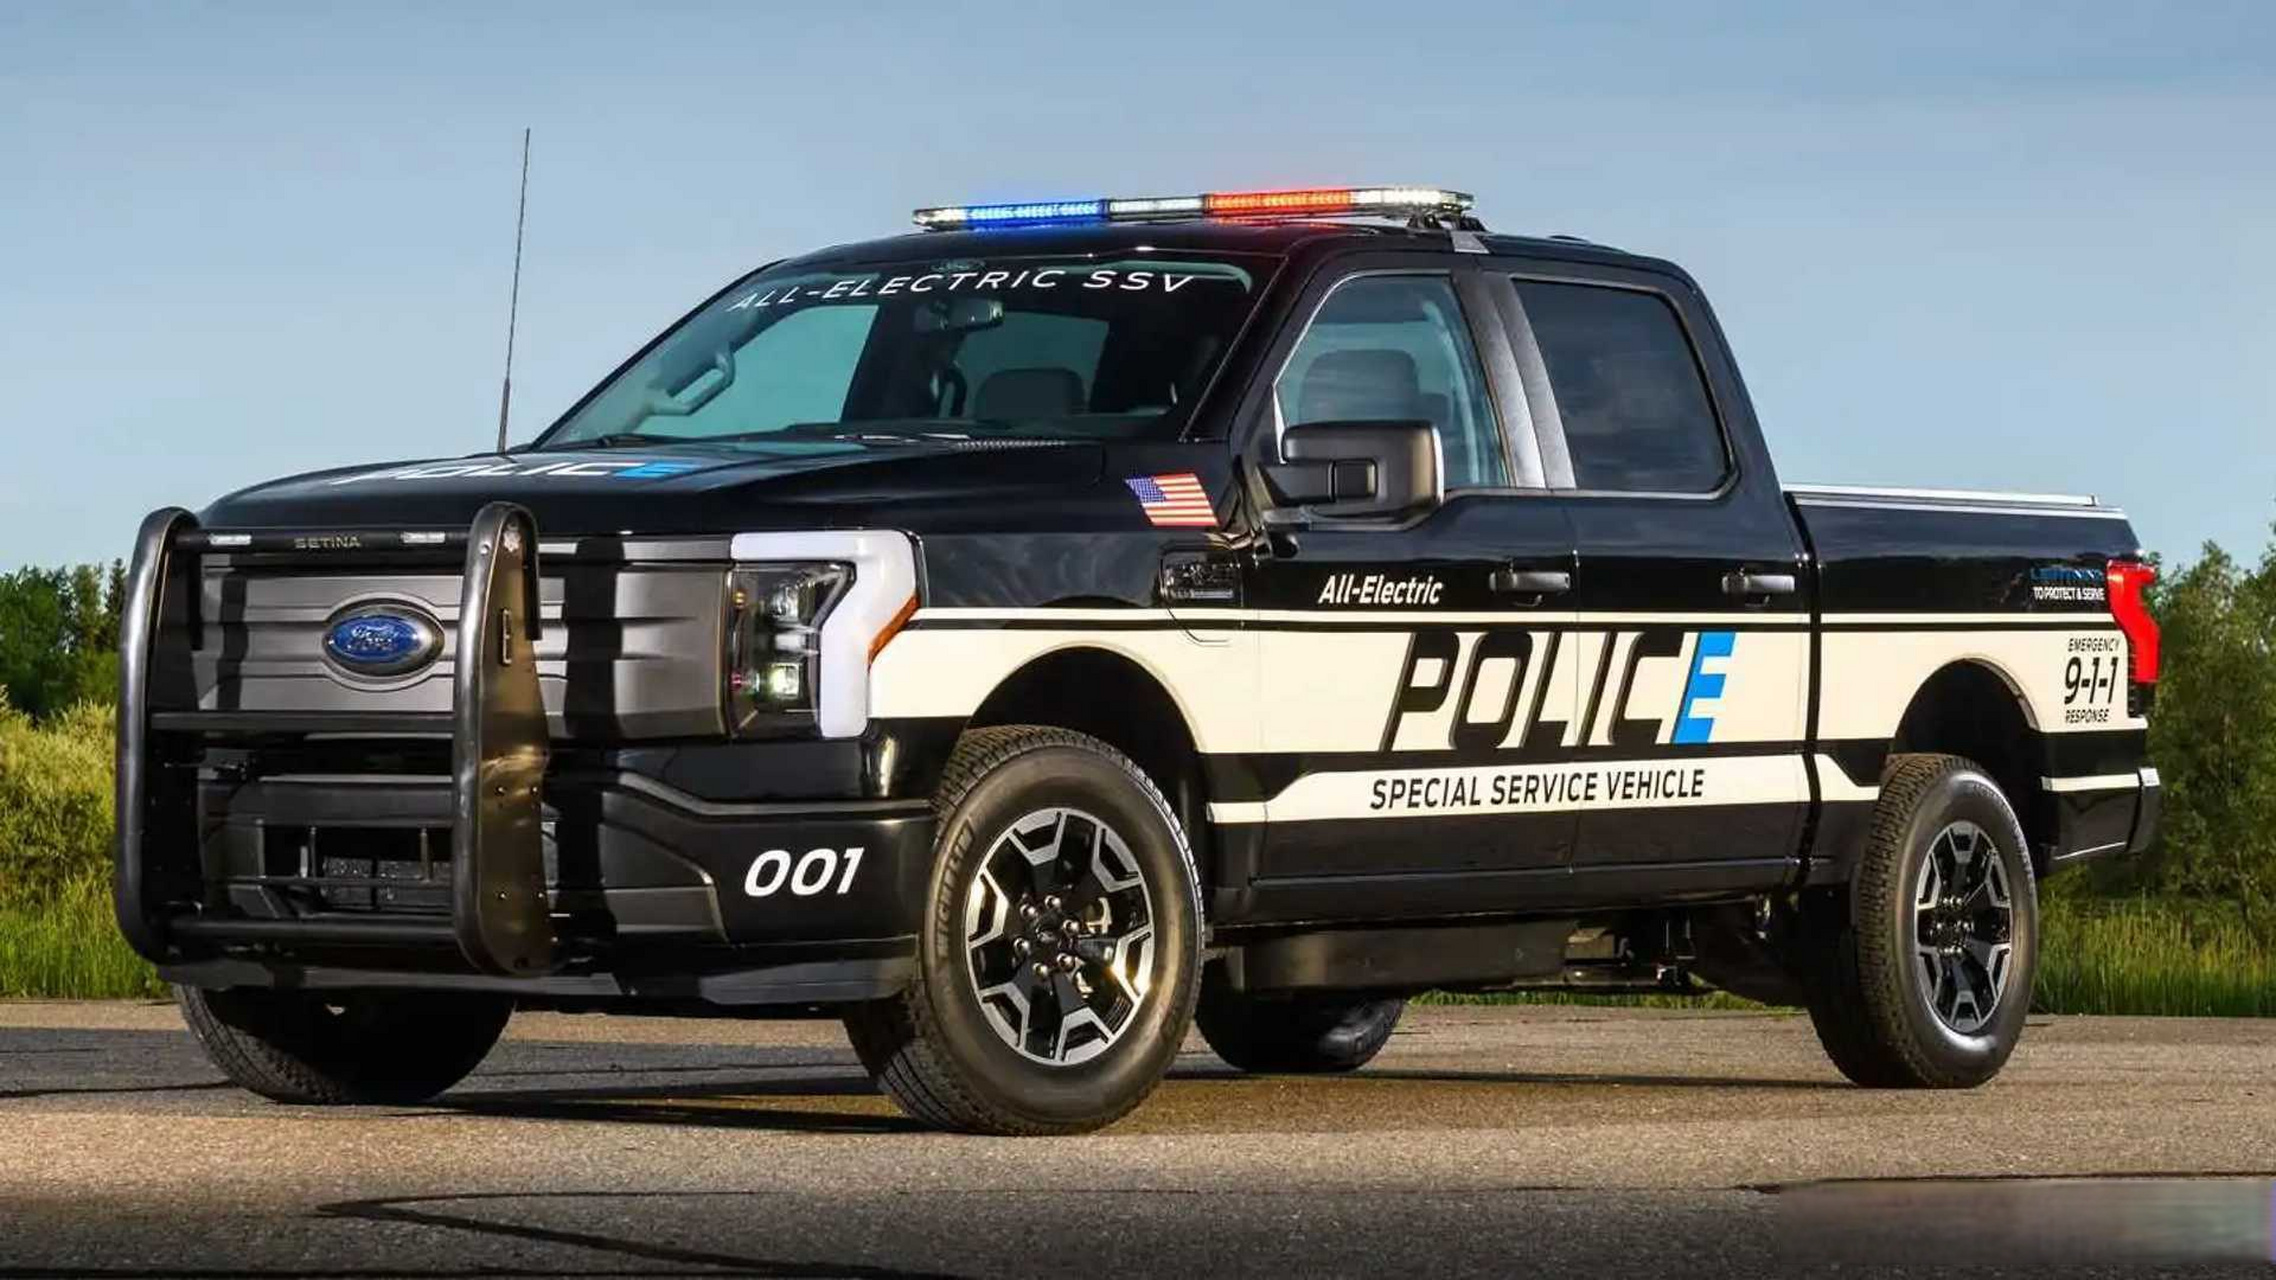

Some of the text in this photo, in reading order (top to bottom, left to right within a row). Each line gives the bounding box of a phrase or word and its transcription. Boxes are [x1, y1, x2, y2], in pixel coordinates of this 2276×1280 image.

[726, 269, 1194, 313] ALL-ELECTRIC SSV
[294, 536, 362, 549] SETINA
[1318, 574, 1444, 605] All-Electric
[2044, 586, 2076, 600] PROTECT
[345, 622, 401, 652] Ford
[2068, 637, 2122, 652] EMERGENCY
[1378, 631, 1737, 751] POLICE
[2064, 656, 2118, 705] 9-1-1
[2065, 708, 2110, 723] RESPONSE
[1370, 768, 1706, 811] SPECIAL SERVICE VEHICLE
[744, 846, 865, 898] 001
